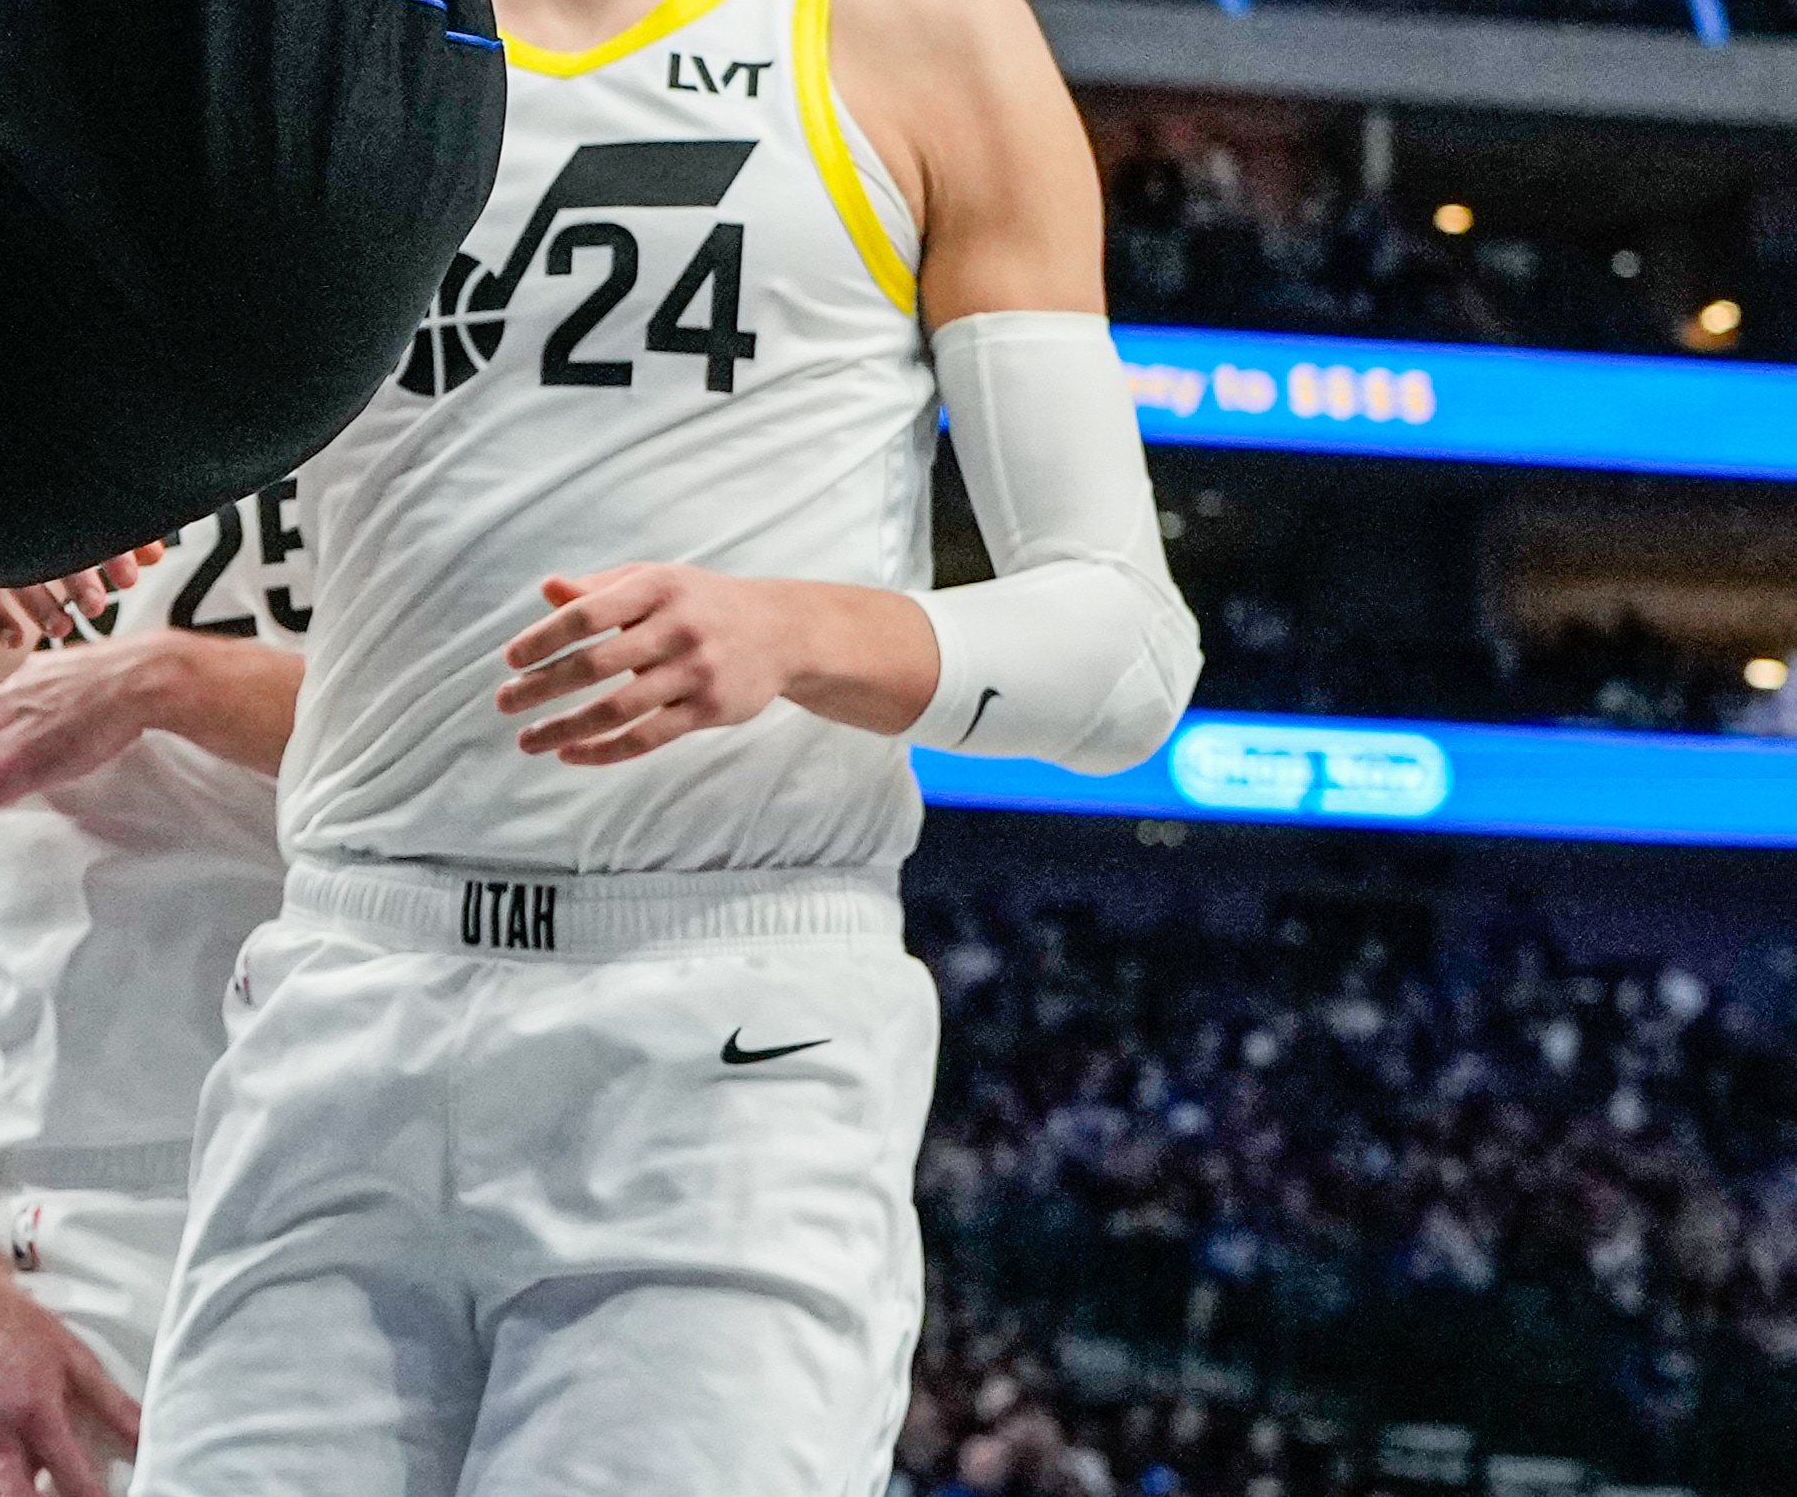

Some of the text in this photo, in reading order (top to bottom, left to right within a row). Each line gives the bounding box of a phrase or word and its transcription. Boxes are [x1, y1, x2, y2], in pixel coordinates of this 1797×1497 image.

[667, 51, 773, 98] LVT
[540, 222, 758, 394] 24
[166, 479, 314, 638] 25
[461, 881, 556, 952] UTAH
